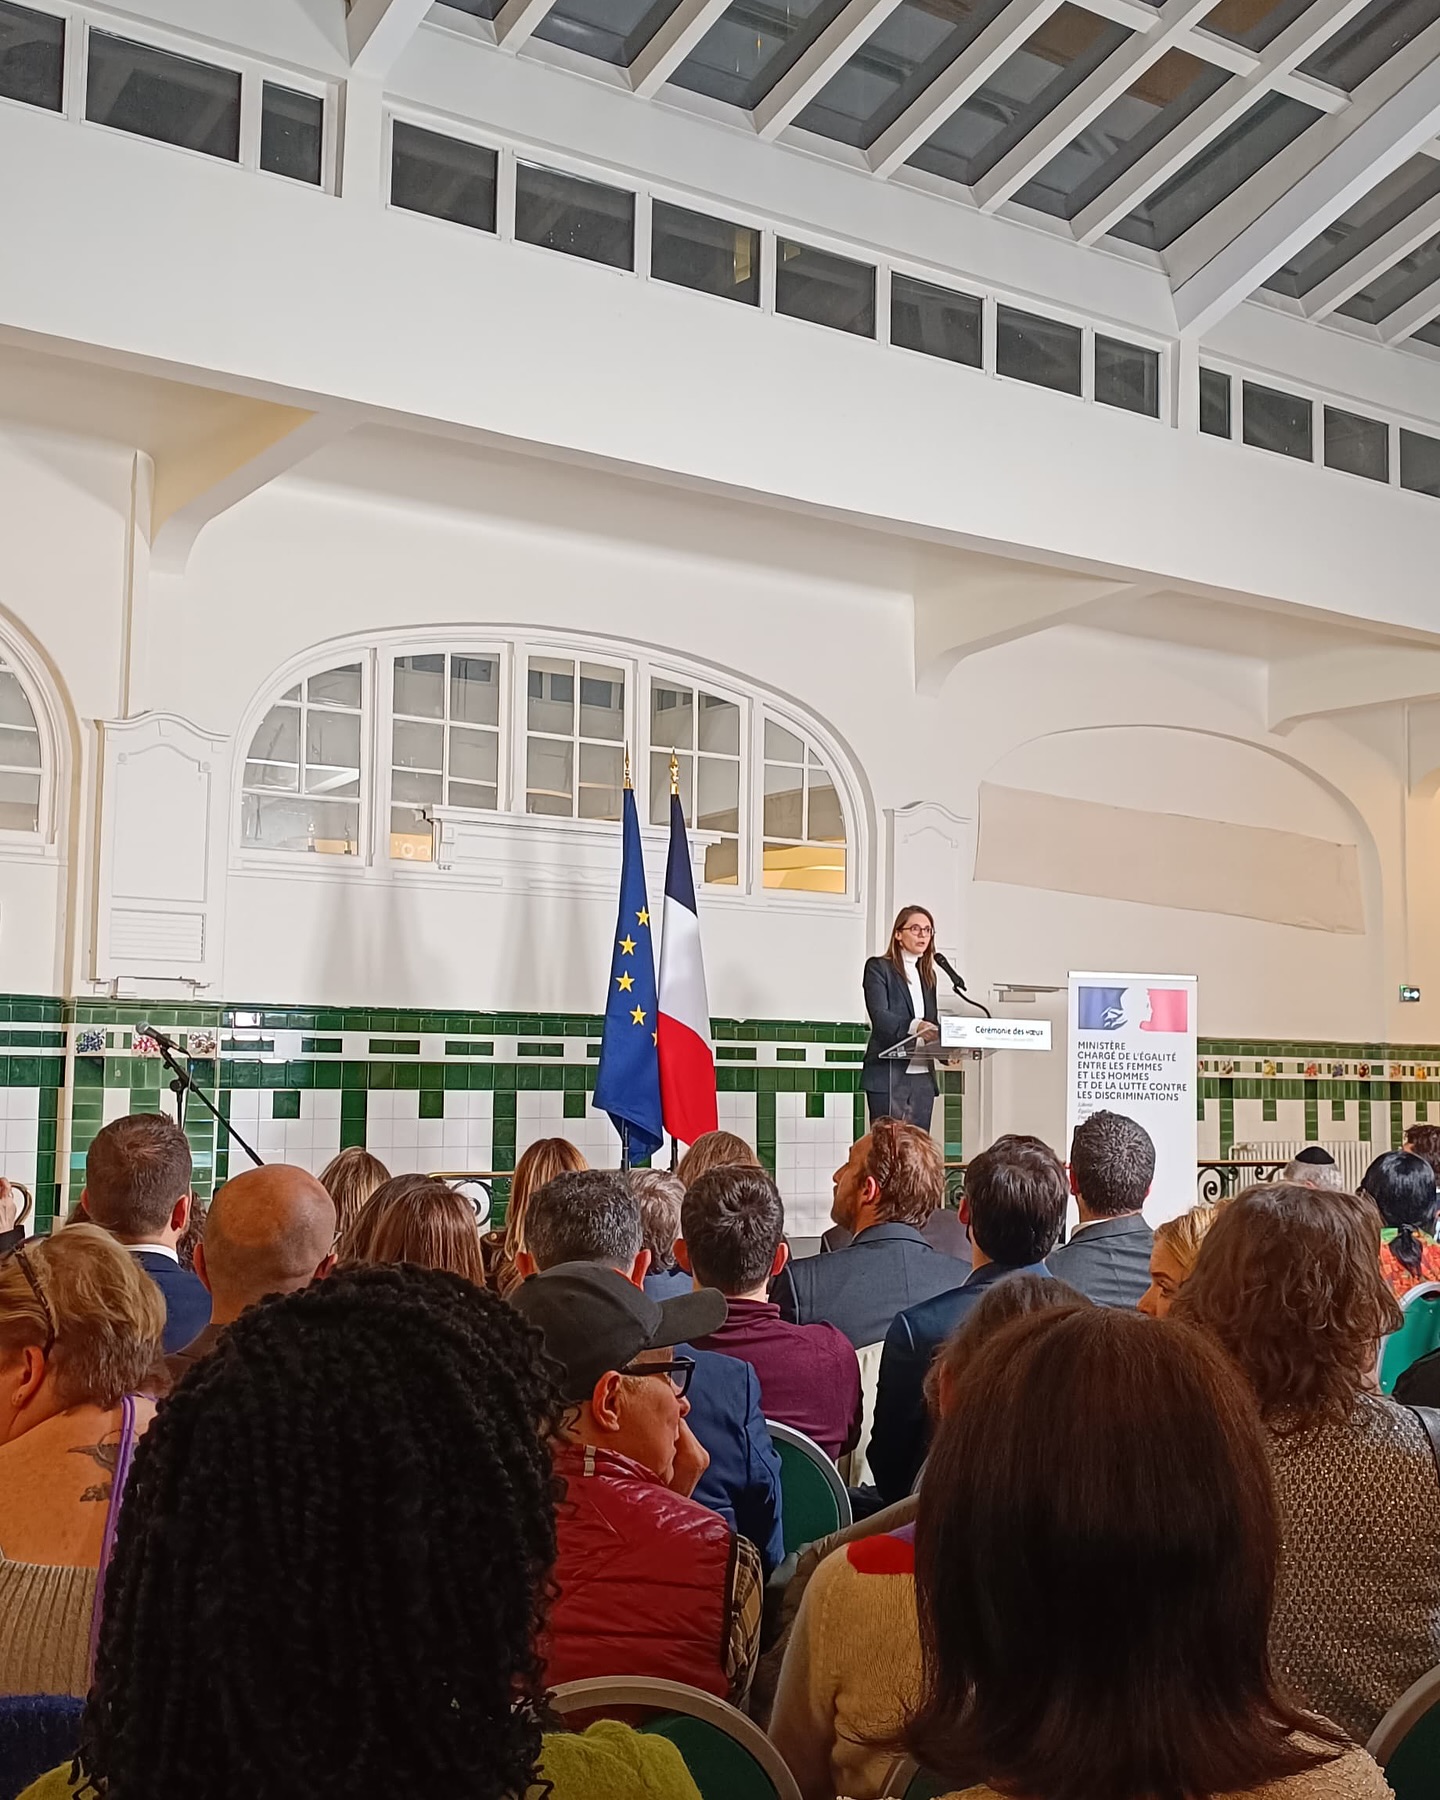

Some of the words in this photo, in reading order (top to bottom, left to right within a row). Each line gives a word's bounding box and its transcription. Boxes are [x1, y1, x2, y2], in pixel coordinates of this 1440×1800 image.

[975, 1025, 1011, 1035] Cérémonie
[1013, 1027, 1024, 1036] des
[1078, 1040, 1126, 1050] MINISTÈRE
[1077, 1051, 1116, 1060] CHARGÉ
[1118, 1052, 1130, 1060] DE
[1133, 1051, 1177, 1062] L'ÉGALITÉ
[1078, 1061, 1106, 1070] ENTRE
[1109, 1062, 1124, 1070] LES
[1126, 1062, 1163, 1071] FEMMES
[1077, 1071, 1088, 1079] ET
[1090, 1071, 1106, 1080] LES
[1108, 1072, 1149, 1081] HOMMES
[1077, 1081, 1088, 1089] ET
[1090, 1081, 1102, 1089] DE
[1105, 1082, 1116, 1090] LA
[1119, 1082, 1147, 1091] LUTTE
[1149, 1083, 1187, 1092] CONTRE
[1077, 1091, 1092, 1099] LES
[1095, 1091, 1179, 1101] DISCRIMINATIONS
